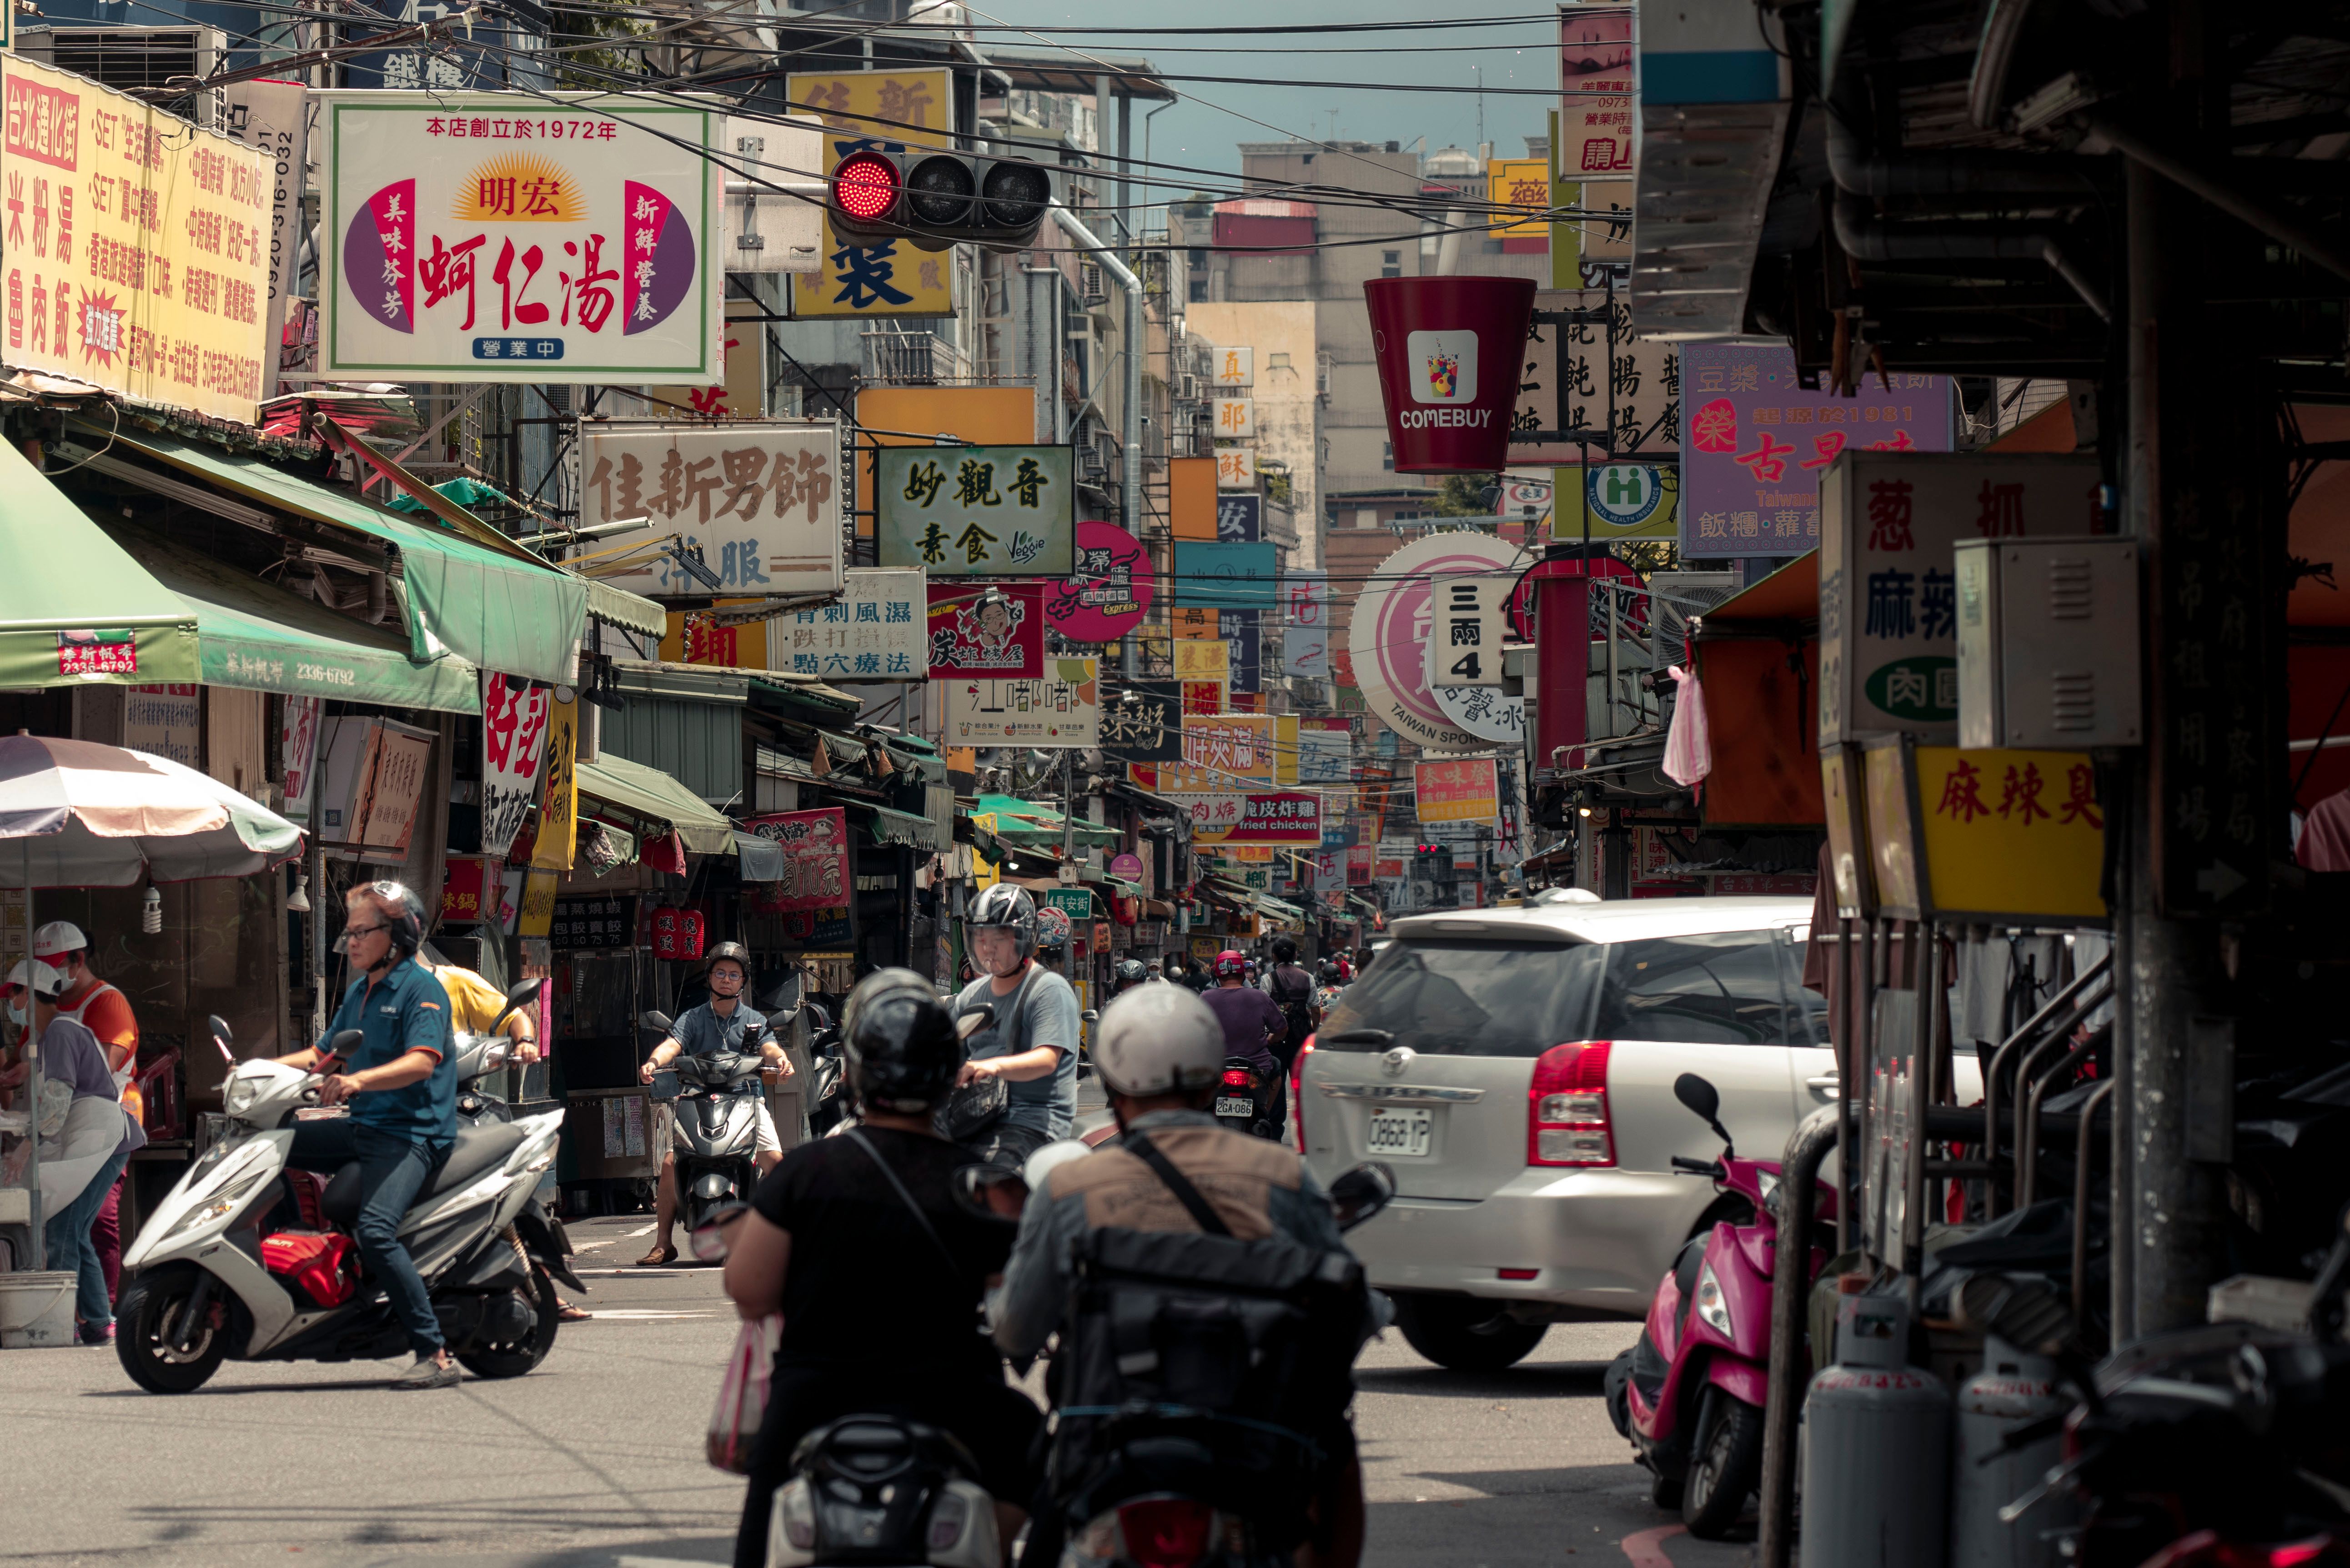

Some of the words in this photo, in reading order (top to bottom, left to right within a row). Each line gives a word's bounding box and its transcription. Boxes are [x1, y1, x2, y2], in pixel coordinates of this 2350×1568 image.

[1585, 112, 1632, 126] 營業時
[1598, 97, 1632, 108] 0973
[9, 86, 76, 163] 台北通化街
[95, 109, 118, 151] SET
[426, 116, 618, 141] 本店創立於1972年
[92, 172, 115, 214] SET
[479, 176, 561, 216] 明宏
[8, 170, 73, 265] 米粉湯
[380, 193, 407, 319] 美味芬芳
[632, 195, 659, 322] 新鮮營養
[8, 268, 70, 360] 魯肉飯
[85, 304, 119, 352] 強力推薦
[482, 339, 555, 357] 營業中
[1697, 366, 1759, 392] 豆漿
[1219, 351, 1249, 483] 真耶穌
[1400, 408, 1491, 429] COMEBUY
[1753, 406, 1913, 425] 起源於1981
[588, 446, 832, 525] 佳新男飾
[904, 458, 1048, 508] 妙觀音
[1589, 487, 1607, 518] NATIONAL
[1609, 515, 1635, 523] HEALTH
[1637, 486, 1661, 519] INSURANCE
[915, 522, 998, 565] 素食
[1005, 530, 1045, 564] Veggie
[1103, 602, 1139, 614] Express
[61, 646, 133, 662] 華新帆布
[62, 661, 134, 674] 2336-6792
[793, 653, 911, 674] 點穴療法
[296, 662, 355, 686] 2336-6792
[1391, 703, 1437, 740] TAIWAN
[1239, 820, 1267, 830] fried
[1270, 819, 1317, 830] chicken
[1054, 895, 1088, 911] 長安街
[658, 915, 676, 952] 蝦餃
[681, 917, 698, 955] 燒賣
[1216, 1101, 1252, 1115] 2GA-086
